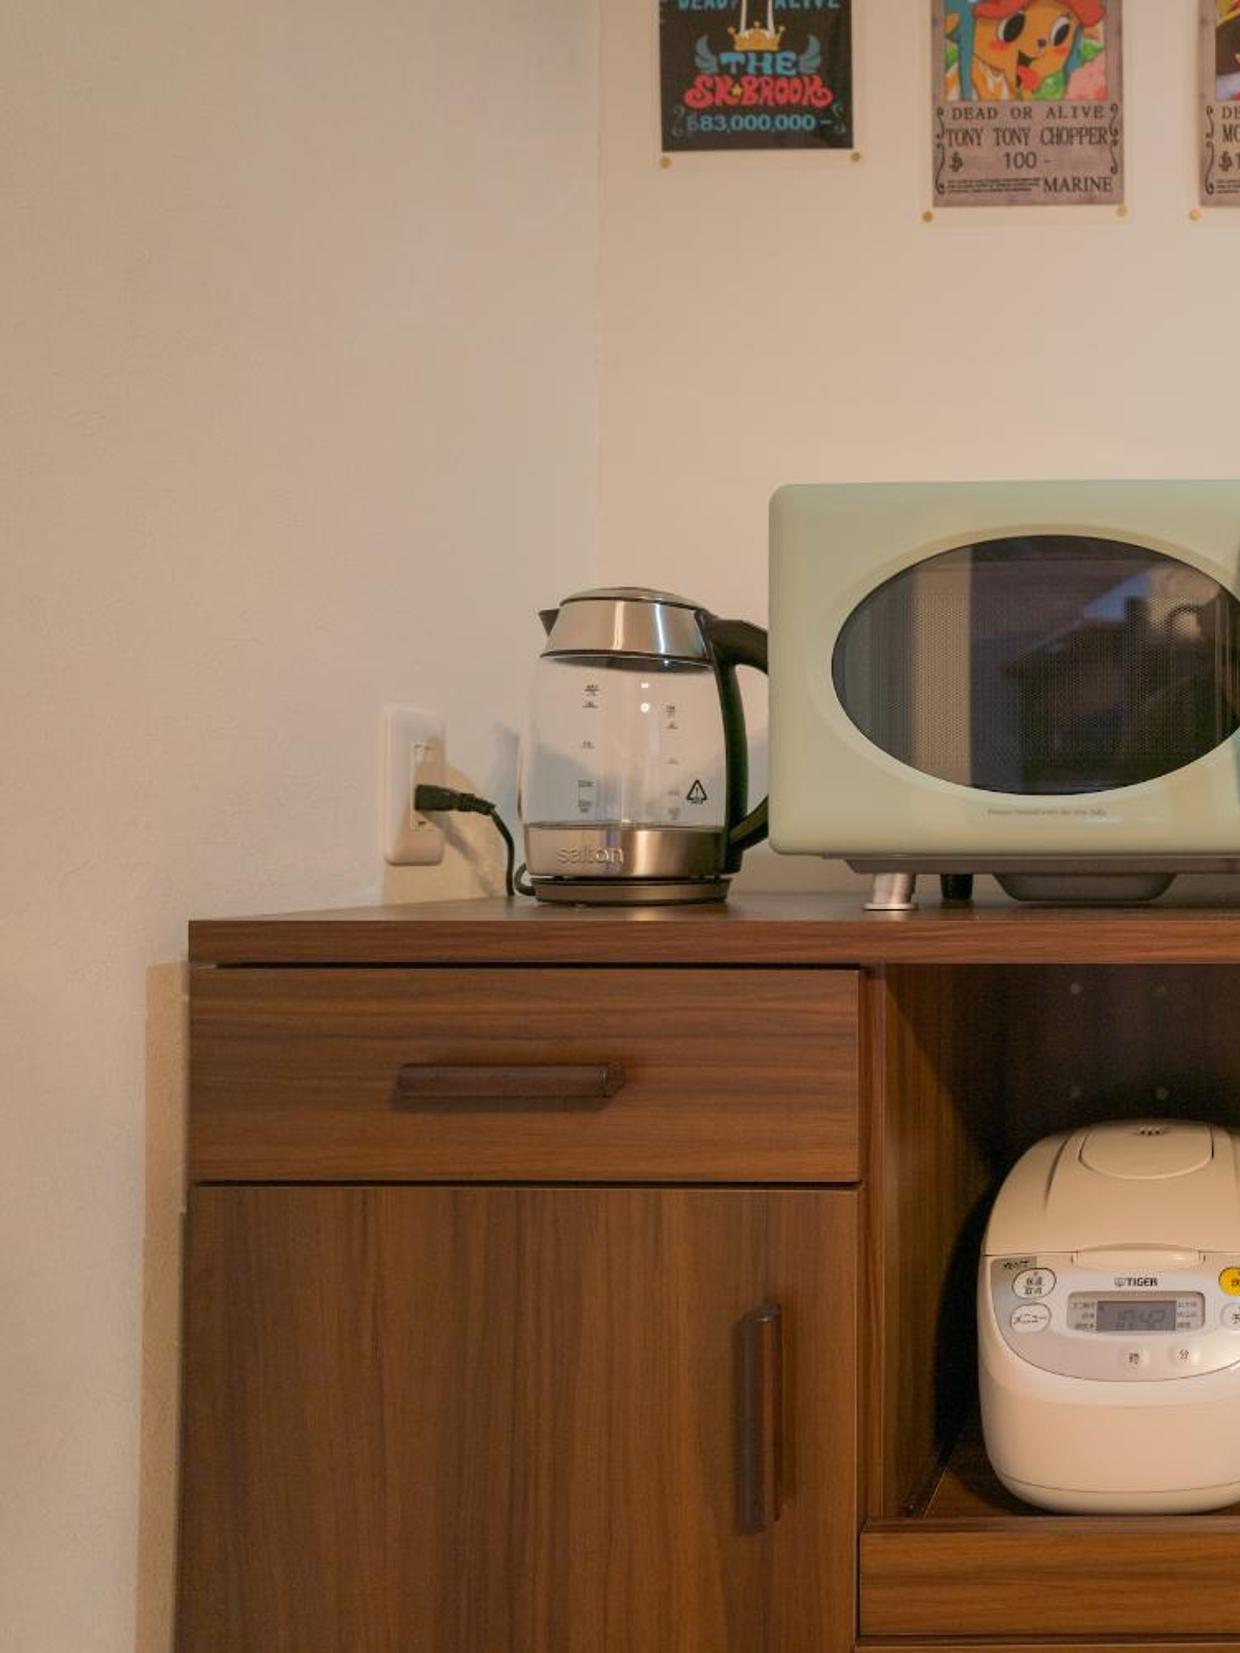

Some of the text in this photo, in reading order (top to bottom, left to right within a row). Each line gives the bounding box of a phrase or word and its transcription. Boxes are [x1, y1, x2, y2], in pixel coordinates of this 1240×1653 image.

[719, 51, 798, 76] THE
[952, 104, 1104, 121] DEAD OR ALIVE
[946, 125, 1108, 148] TONY TONY CHOPPER
[1003, 151, 1038, 169] 100
[1043, 176, 1113, 193] MARINE
[1126, 1277, 1158, 1288] TIGER
